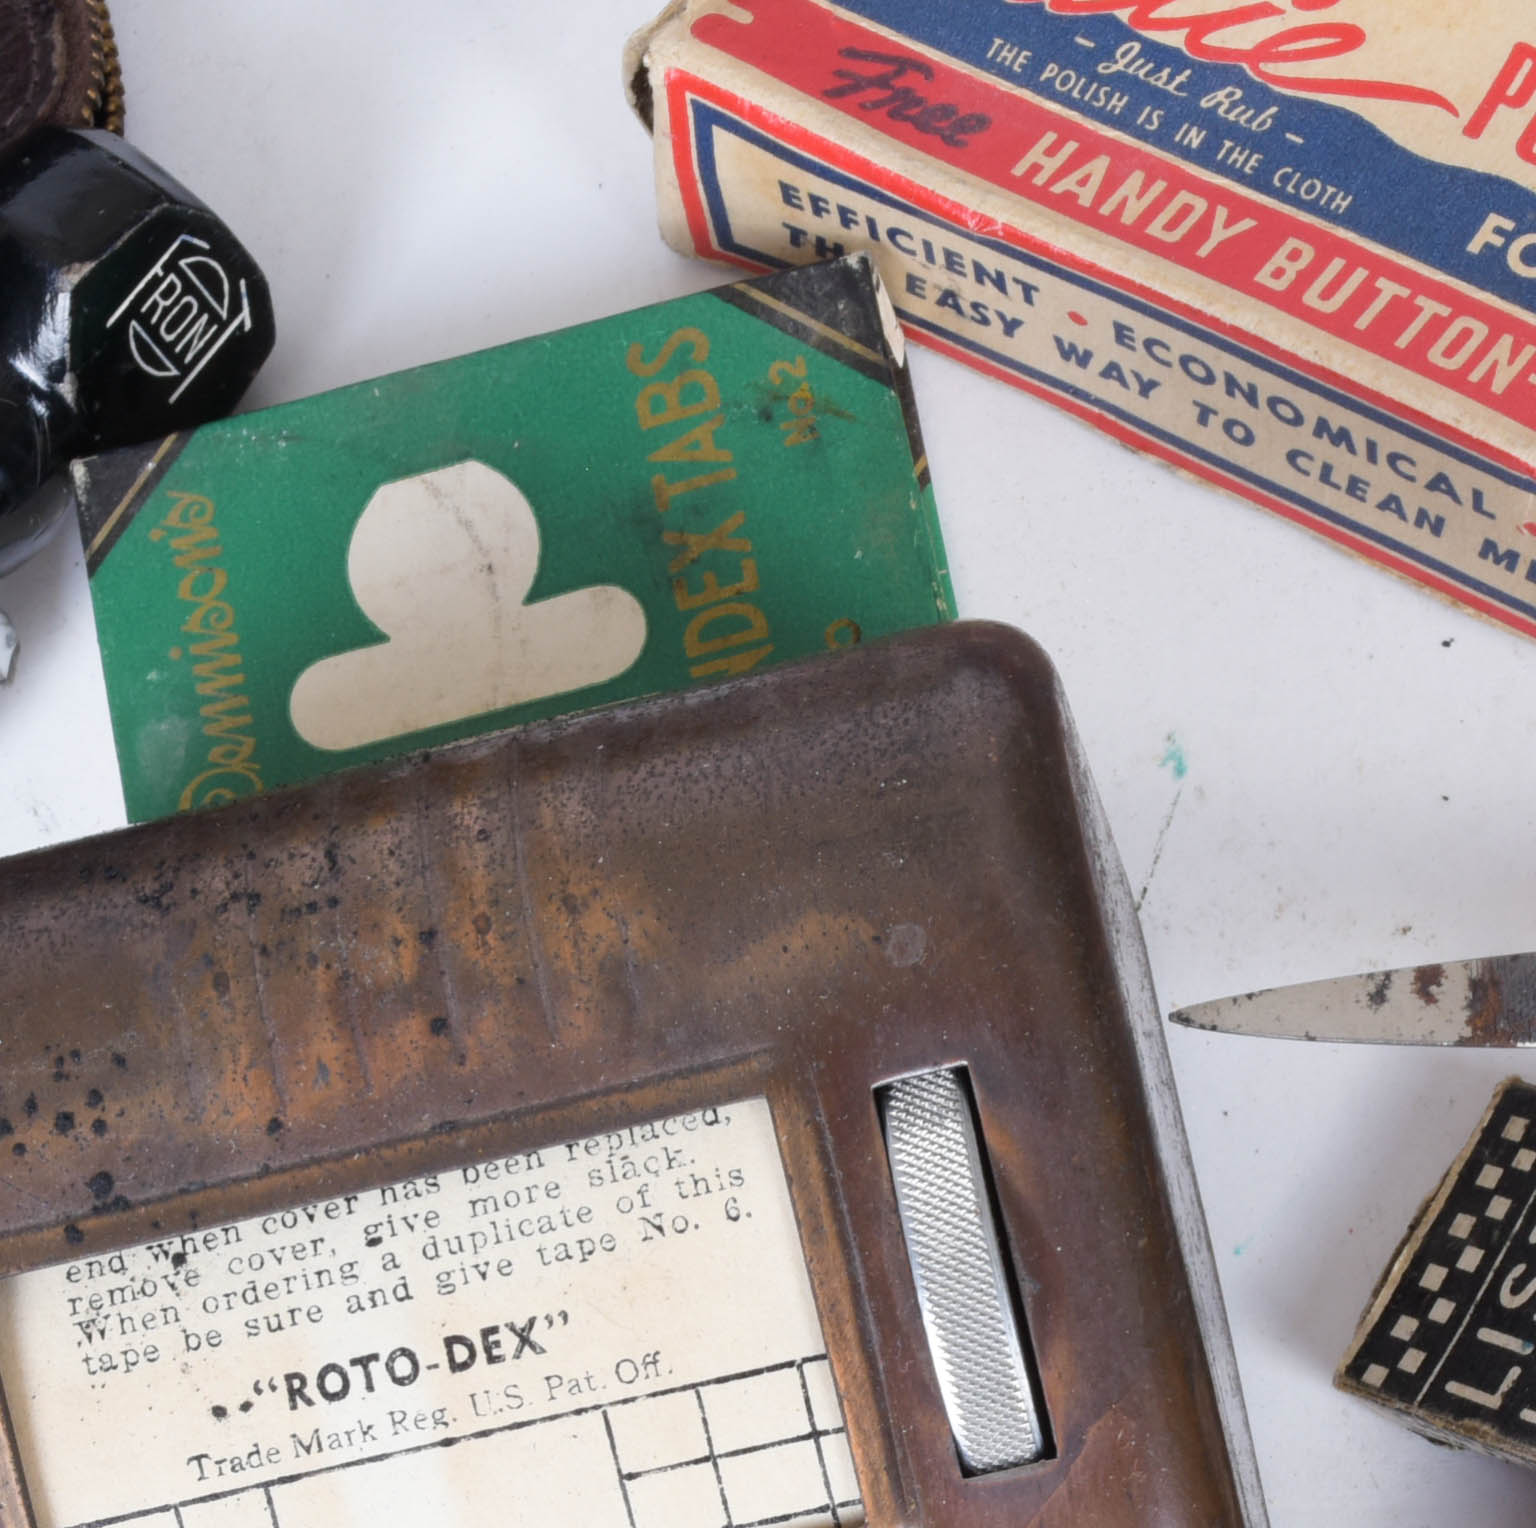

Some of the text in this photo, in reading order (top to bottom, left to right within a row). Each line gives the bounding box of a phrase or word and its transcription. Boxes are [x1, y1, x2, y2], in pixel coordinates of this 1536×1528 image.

[821, 46, 993, 148] Free
[1010, 130, 1258, 260] HANDY
[985, 37, 1354, 216] THE POLISH IS IN THE CLOTH
[1098, 40, 1188, 97] Just
[1200, 87, 1279, 132] Rub
[777, 179, 1040, 306] EFFICIENT
[1111, 320, 1497, 519] ECONOMICAL
[781, 223, 845, 259] TH
[905, 272, 1025, 338] EASY
[1053, 334, 1161, 400] WAY
[1192, 400, 1257, 450] TO
[1285, 449, 1446, 540] CLEAN
[626, 326, 775, 678] NDEX TABS
[66, 1251, 129, 1283] end
[147, 1224, 244, 1262] when
[261, 1193, 360, 1236] cover
[380, 1174, 441, 1206] has
[462, 1150, 546, 1185] been
[67, 1146, 696, 1316] remove cover, give more slack.
[73, 1166, 746, 1345] When ordering a duplicate of this
[81, 1196, 753, 1376] tape be sure and give tape No. 6.
[186, 1350, 675, 1483] Trade Mark Reg. U.S. Pat. Off.
